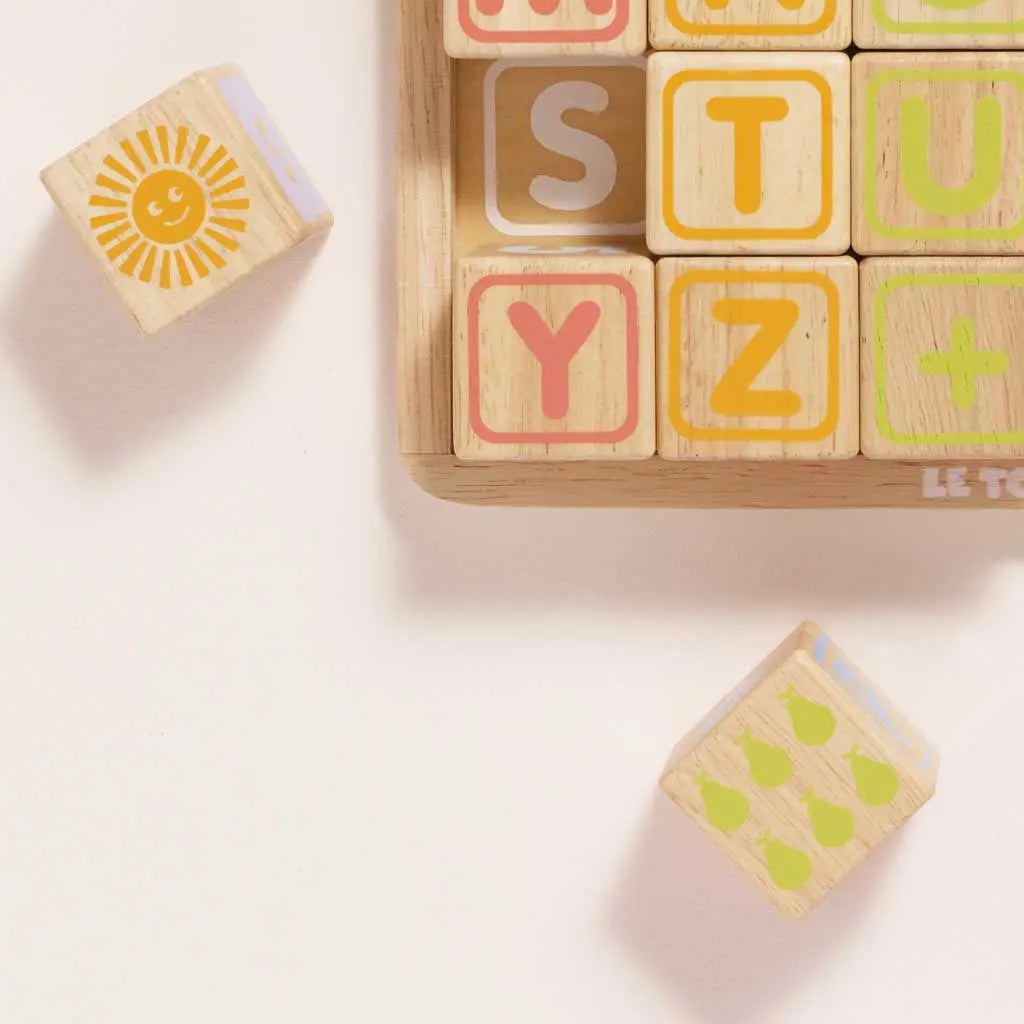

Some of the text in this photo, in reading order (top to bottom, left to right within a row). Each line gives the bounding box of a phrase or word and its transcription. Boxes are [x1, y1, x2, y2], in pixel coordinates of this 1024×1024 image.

[529, 80, 617, 211] S
[706, 96, 789, 215] T
[901, 96, 1001, 215] U
[507, 300, 600, 420] Y
[709, 299, 802, 417] Z
[921, 466, 971, 499] LE
